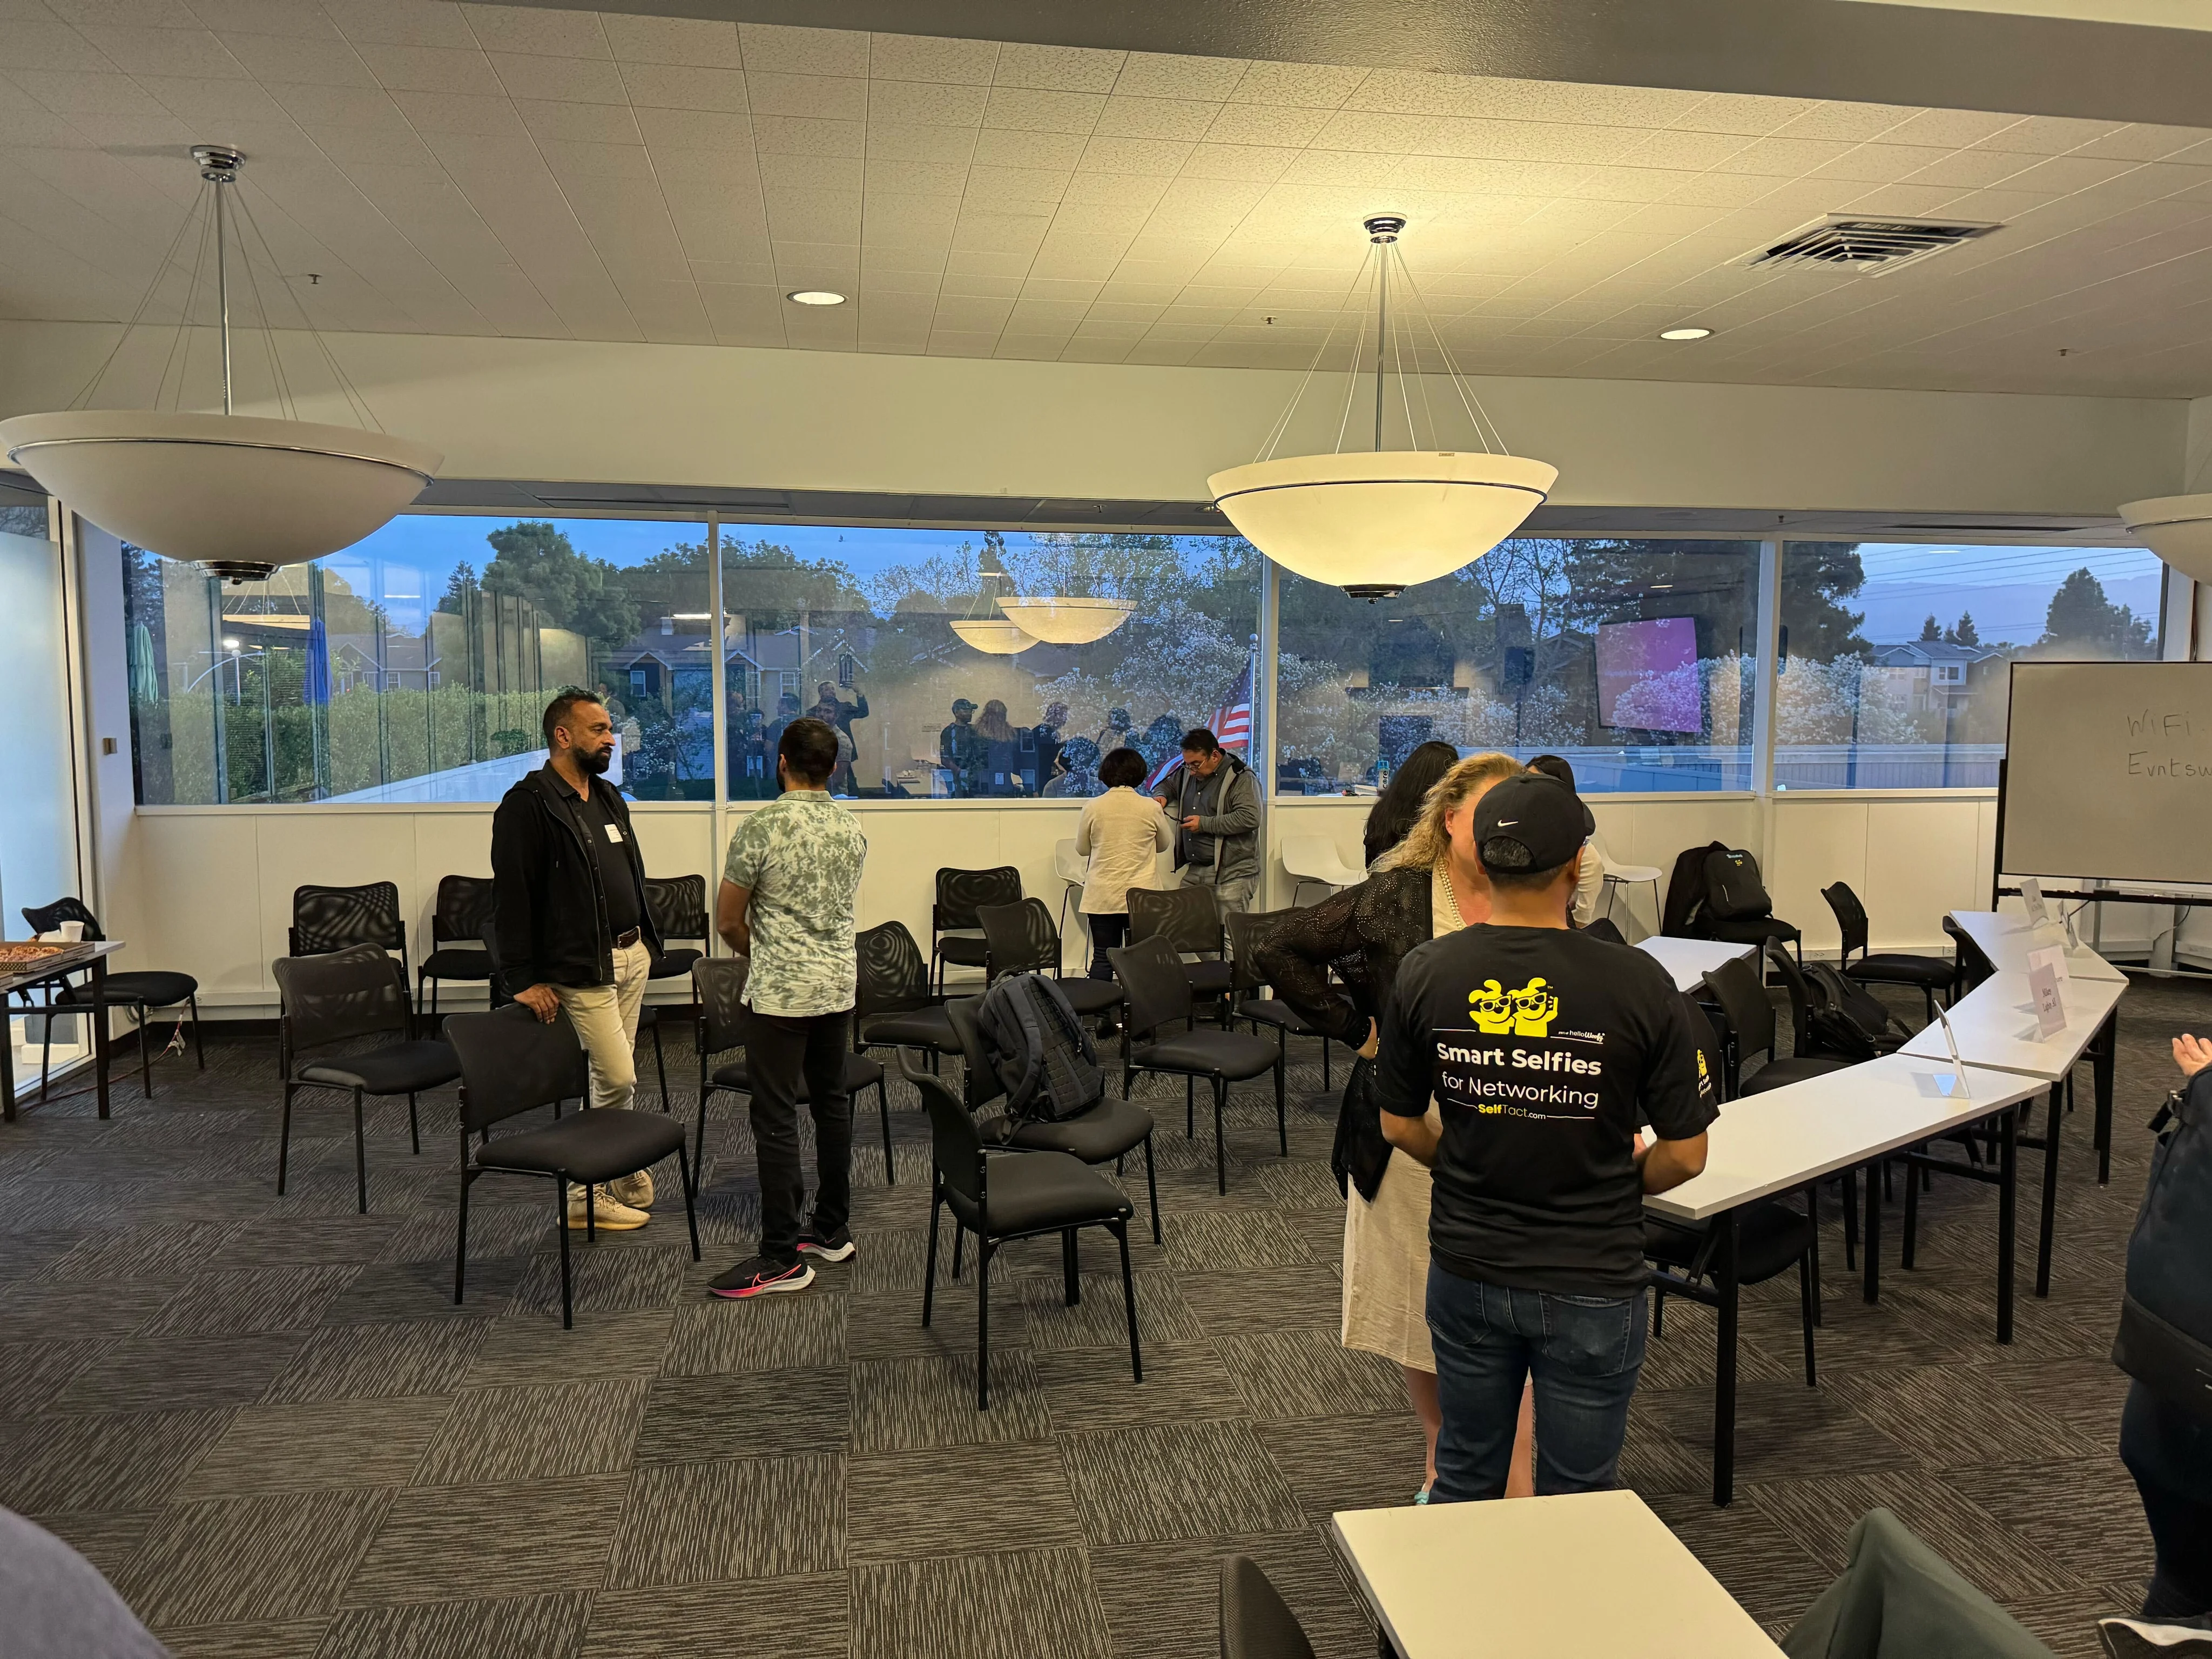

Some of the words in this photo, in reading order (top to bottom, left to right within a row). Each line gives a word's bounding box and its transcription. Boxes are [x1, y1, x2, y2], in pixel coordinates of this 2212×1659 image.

[1437, 1042, 1505, 1066] Smart
[1512, 1049, 1602, 1075] Selfies
[1442, 1071, 1464, 1090] for
[1469, 1076, 1599, 1109] Networking
[1478, 1104, 1546, 1120] SelfTact.com
